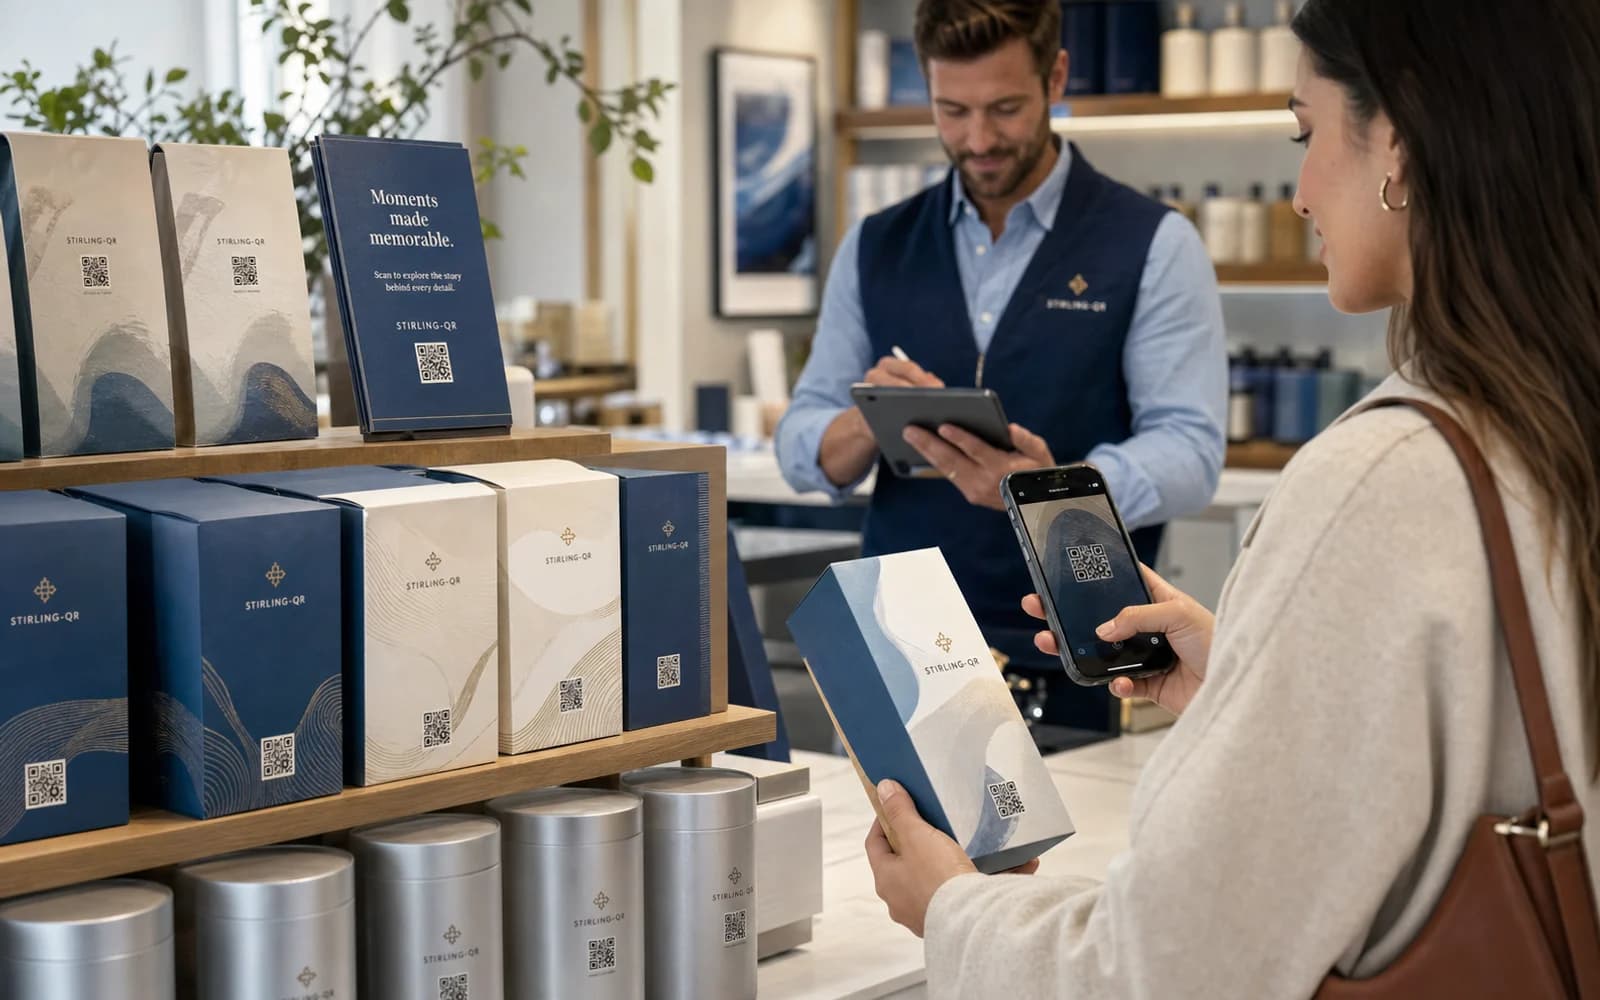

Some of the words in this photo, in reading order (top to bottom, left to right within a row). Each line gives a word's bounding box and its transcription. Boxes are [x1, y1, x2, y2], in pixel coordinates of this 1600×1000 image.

[370, 189, 439, 208] Moments
[389, 210, 430, 227] made
[66, 236, 118, 245] STIRLING-QR
[216, 237, 265, 246] STIRLING-QR
[369, 231, 455, 248] memorable.
[374, 270, 392, 280] Scan
[393, 271, 402, 280] to
[402, 271, 430, 282] explore
[430, 271, 443, 280] the
[443, 272, 462, 282] story
[385, 283, 411, 292] behind
[411, 284, 432, 294] every
[432, 283, 457, 292] detail.
[396, 321, 457, 331] STIRLING-QR
[648, 541, 689, 553] STIRLING-QR
[545, 552, 592, 565] STIRLING-QR
[406, 576, 461, 591] STIRLING-QR
[245, 595, 306, 611] STIRLING-QR
[10, 611, 80, 627] STIRLING-QR
[924, 657, 980, 676] STIRLING-QR
[712, 886, 754, 902] STIRLING-QR
[573, 912, 625, 928] STIRLING-QR
[423, 947, 480, 965] STIRLING-QR
